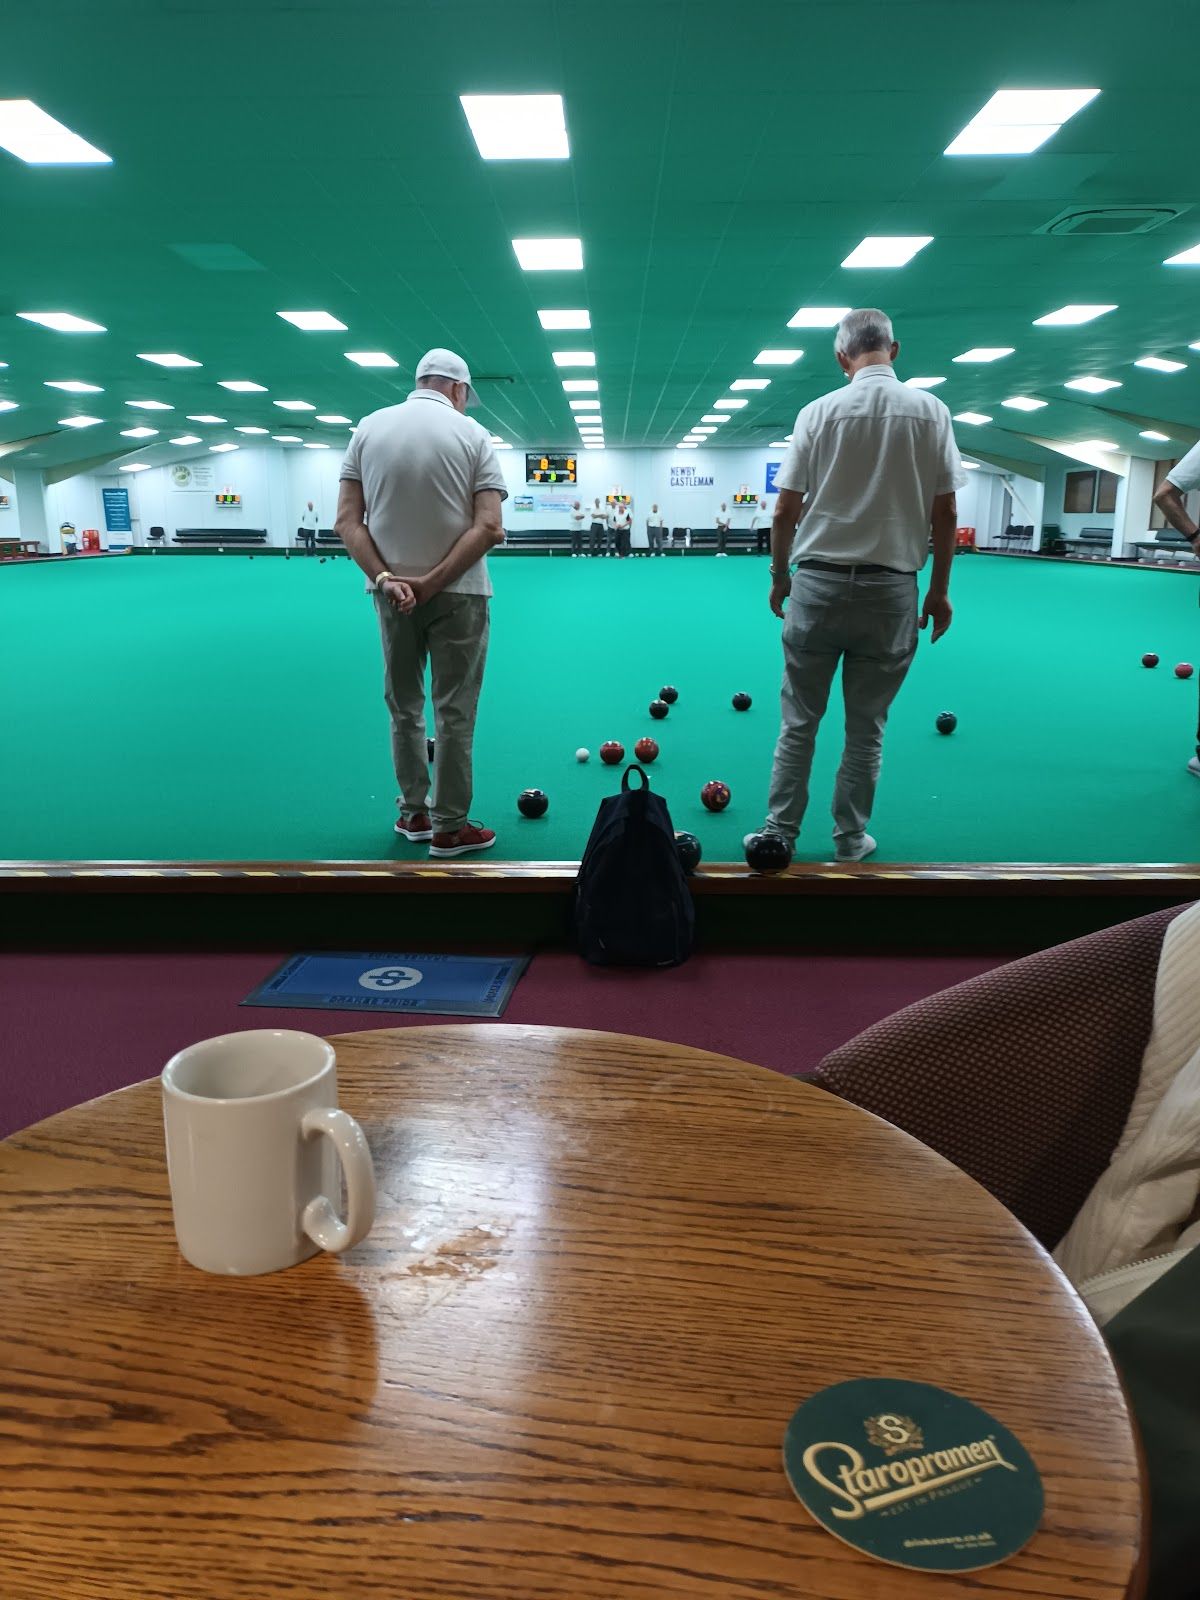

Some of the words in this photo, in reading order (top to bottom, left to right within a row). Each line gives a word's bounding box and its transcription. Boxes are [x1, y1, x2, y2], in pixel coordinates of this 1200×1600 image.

[670, 466, 697, 477] NEWBY
[670, 476, 714, 487] CASTLEMAN
[876, 1414, 911, 1444] S
[802, 1438, 1016, 1520] Staropramen
